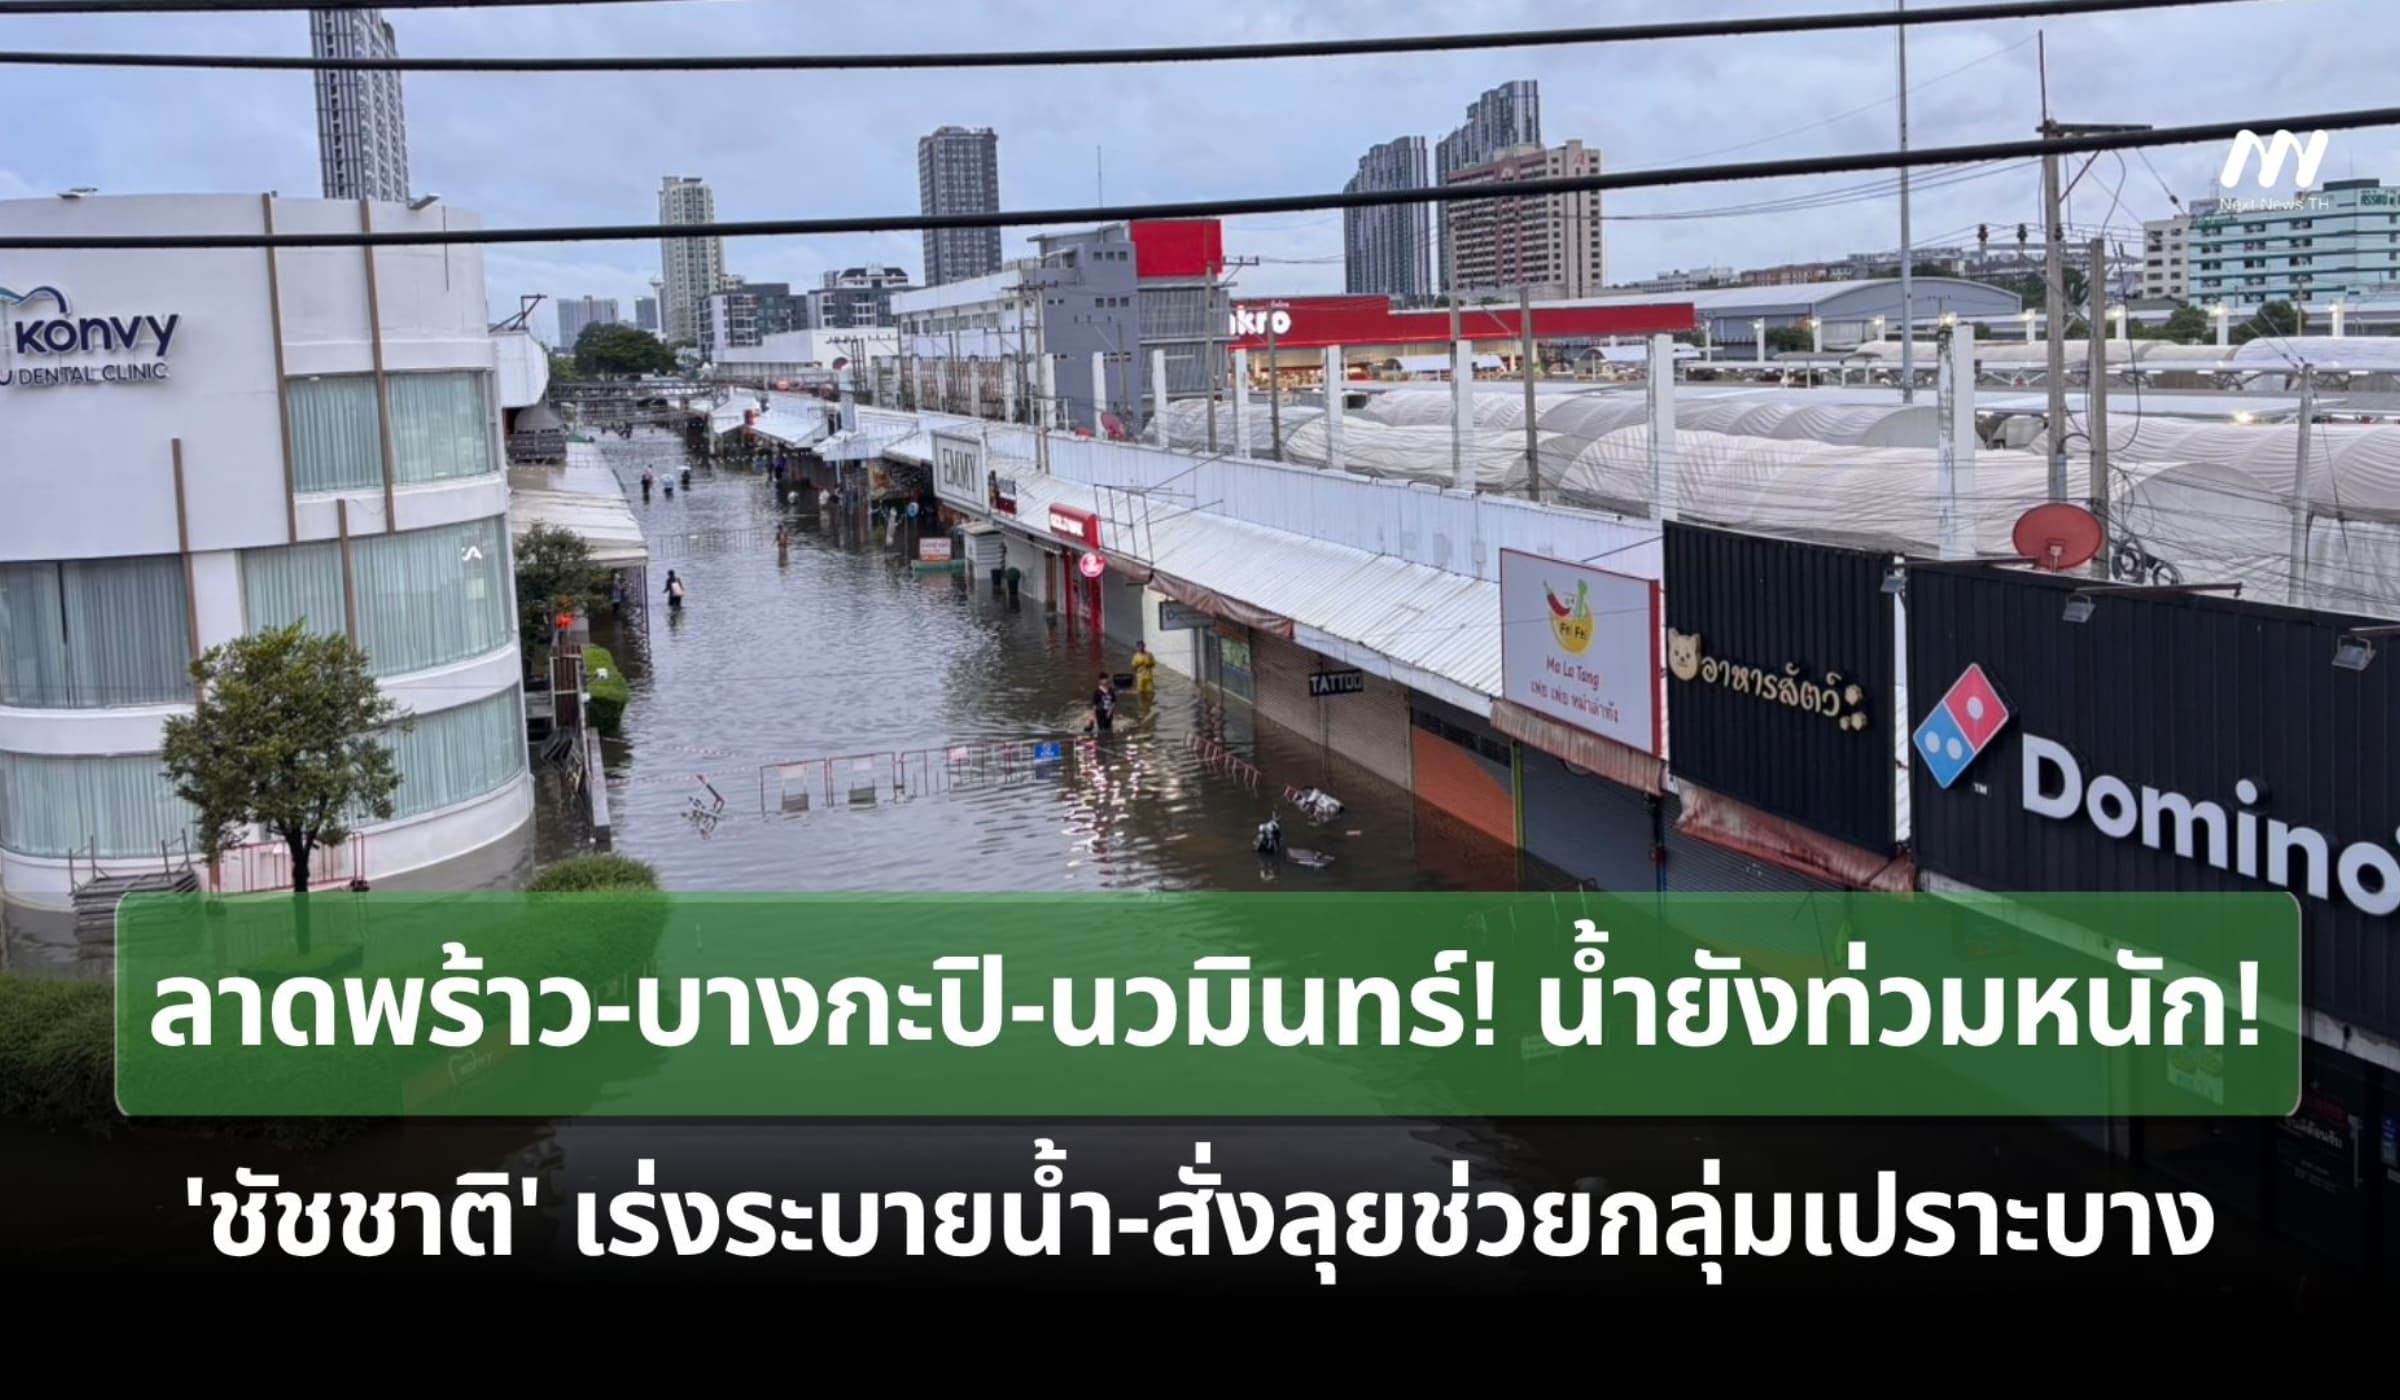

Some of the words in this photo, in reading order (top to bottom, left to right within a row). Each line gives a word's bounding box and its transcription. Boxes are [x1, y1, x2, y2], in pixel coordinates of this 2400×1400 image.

[15, 313, 179, 357] konvy
[19, 366, 95, 385] DENTAL
[102, 362, 168, 382] CLINIC
[943, 448, 977, 493] EMMY
[1546, 655, 1561, 674] Ma
[1563, 661, 1575, 679] La
[1577, 666, 1600, 692] Tang
[1701, 656, 1842, 717] อาหารสัตว์
[2022, 732, 2400, 915] Domino
